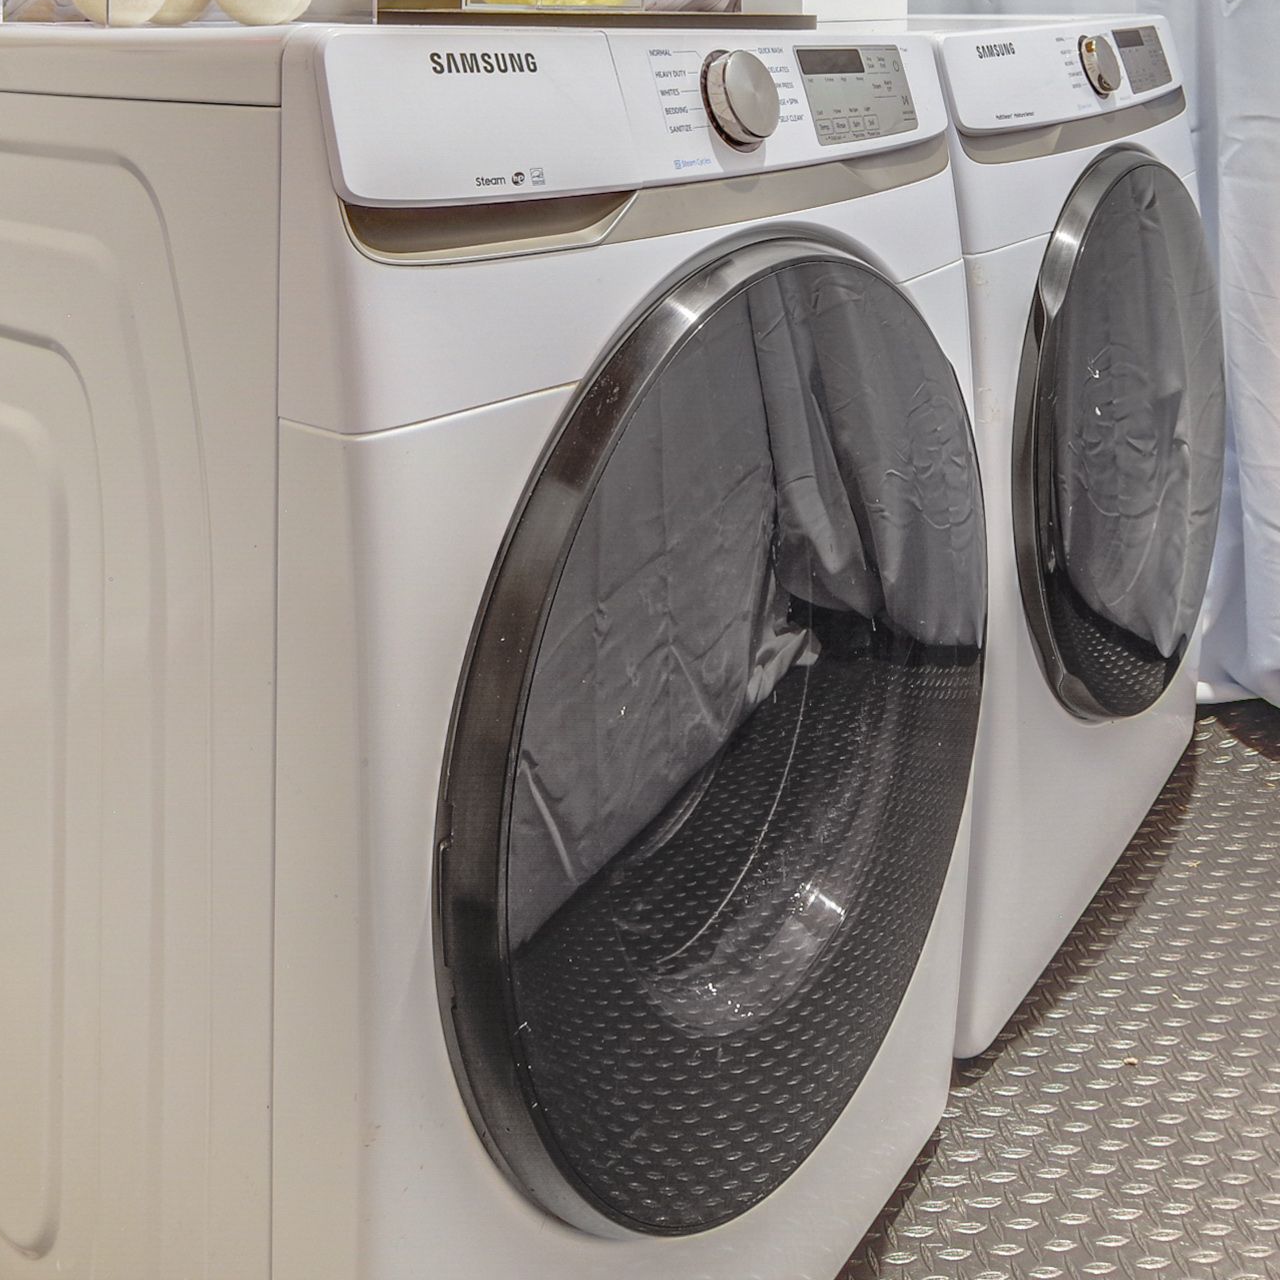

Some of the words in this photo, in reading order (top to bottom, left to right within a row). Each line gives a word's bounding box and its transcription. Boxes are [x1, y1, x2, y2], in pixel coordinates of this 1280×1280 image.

[649, 49, 672, 57] NORMAL
[975, 42, 1016, 59] SAMSUNG
[429, 52, 538, 74] SAMSUNG
[660, 88, 680, 96] WHITES
[665, 106, 688, 115] BEDDING
[669, 124, 693, 134] SANITIZE
[475, 176, 506, 187] Steam
